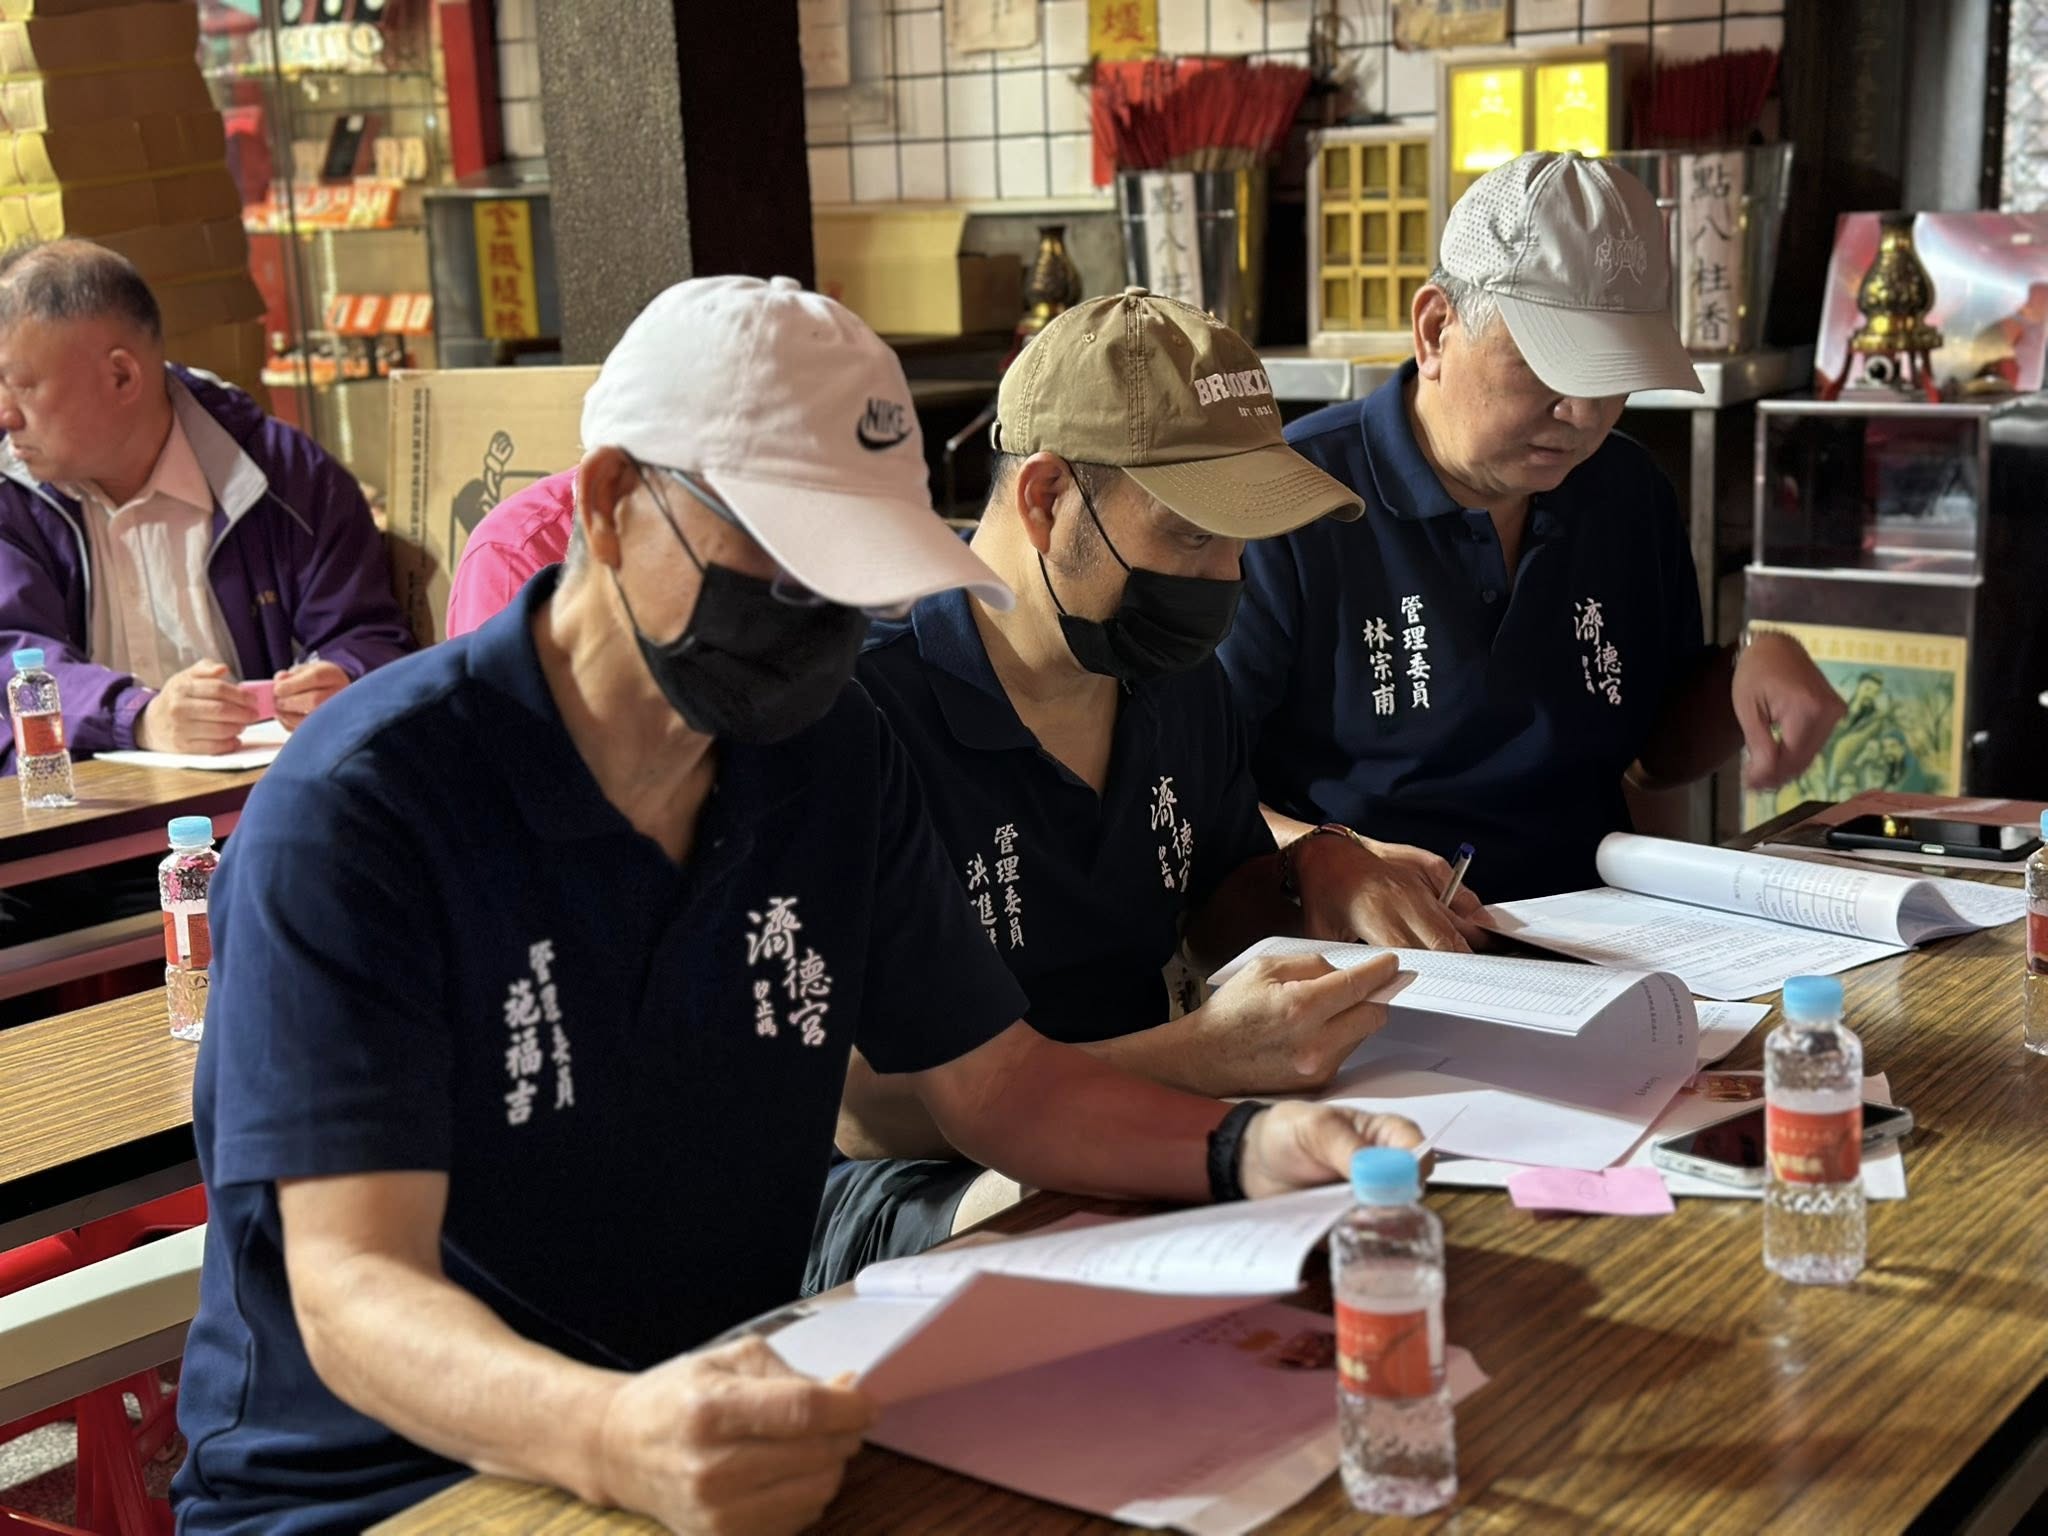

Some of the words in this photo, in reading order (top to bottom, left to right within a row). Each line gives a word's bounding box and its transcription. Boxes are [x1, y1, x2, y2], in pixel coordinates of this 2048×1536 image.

[1691, 159, 1733, 341] 點八柱香
[866, 396, 906, 434] NIKE
[1362, 616, 1395, 716] 林宗甫
[1401, 594, 1431, 709] 管理委員
[1573, 597, 1622, 705] 濟德宮
[994, 823, 1025, 950] 管理委員
[746, 897, 833, 1047] 濟德宮
